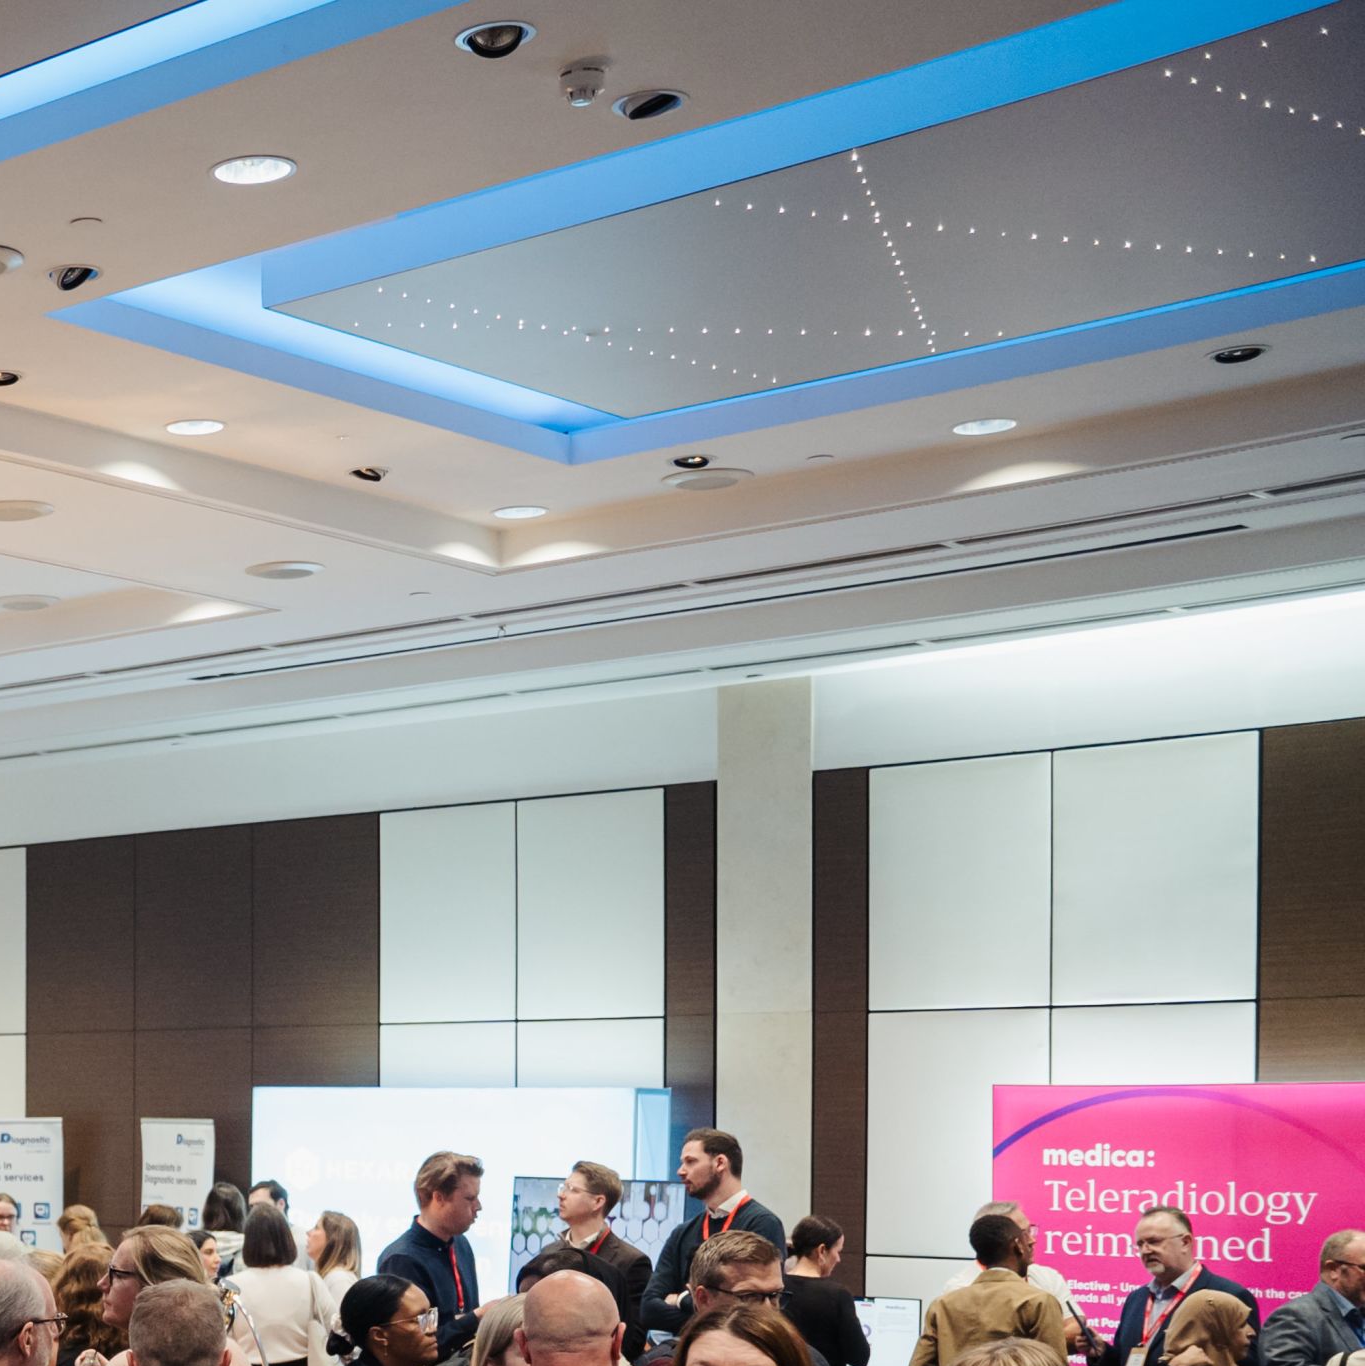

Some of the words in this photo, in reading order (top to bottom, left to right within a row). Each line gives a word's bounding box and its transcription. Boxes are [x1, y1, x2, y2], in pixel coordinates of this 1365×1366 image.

[0, 1133, 51, 1145] Diagnostic
[1042, 1143, 1156, 1168] medica:
[3, 1162, 12, 1170] in
[1043, 1178, 1318, 1225] Teleradiology
[1044, 1225, 1273, 1262] reimned
[1067, 1279, 1111, 1291] Elective
[1265, 1288, 1286, 1299] the
